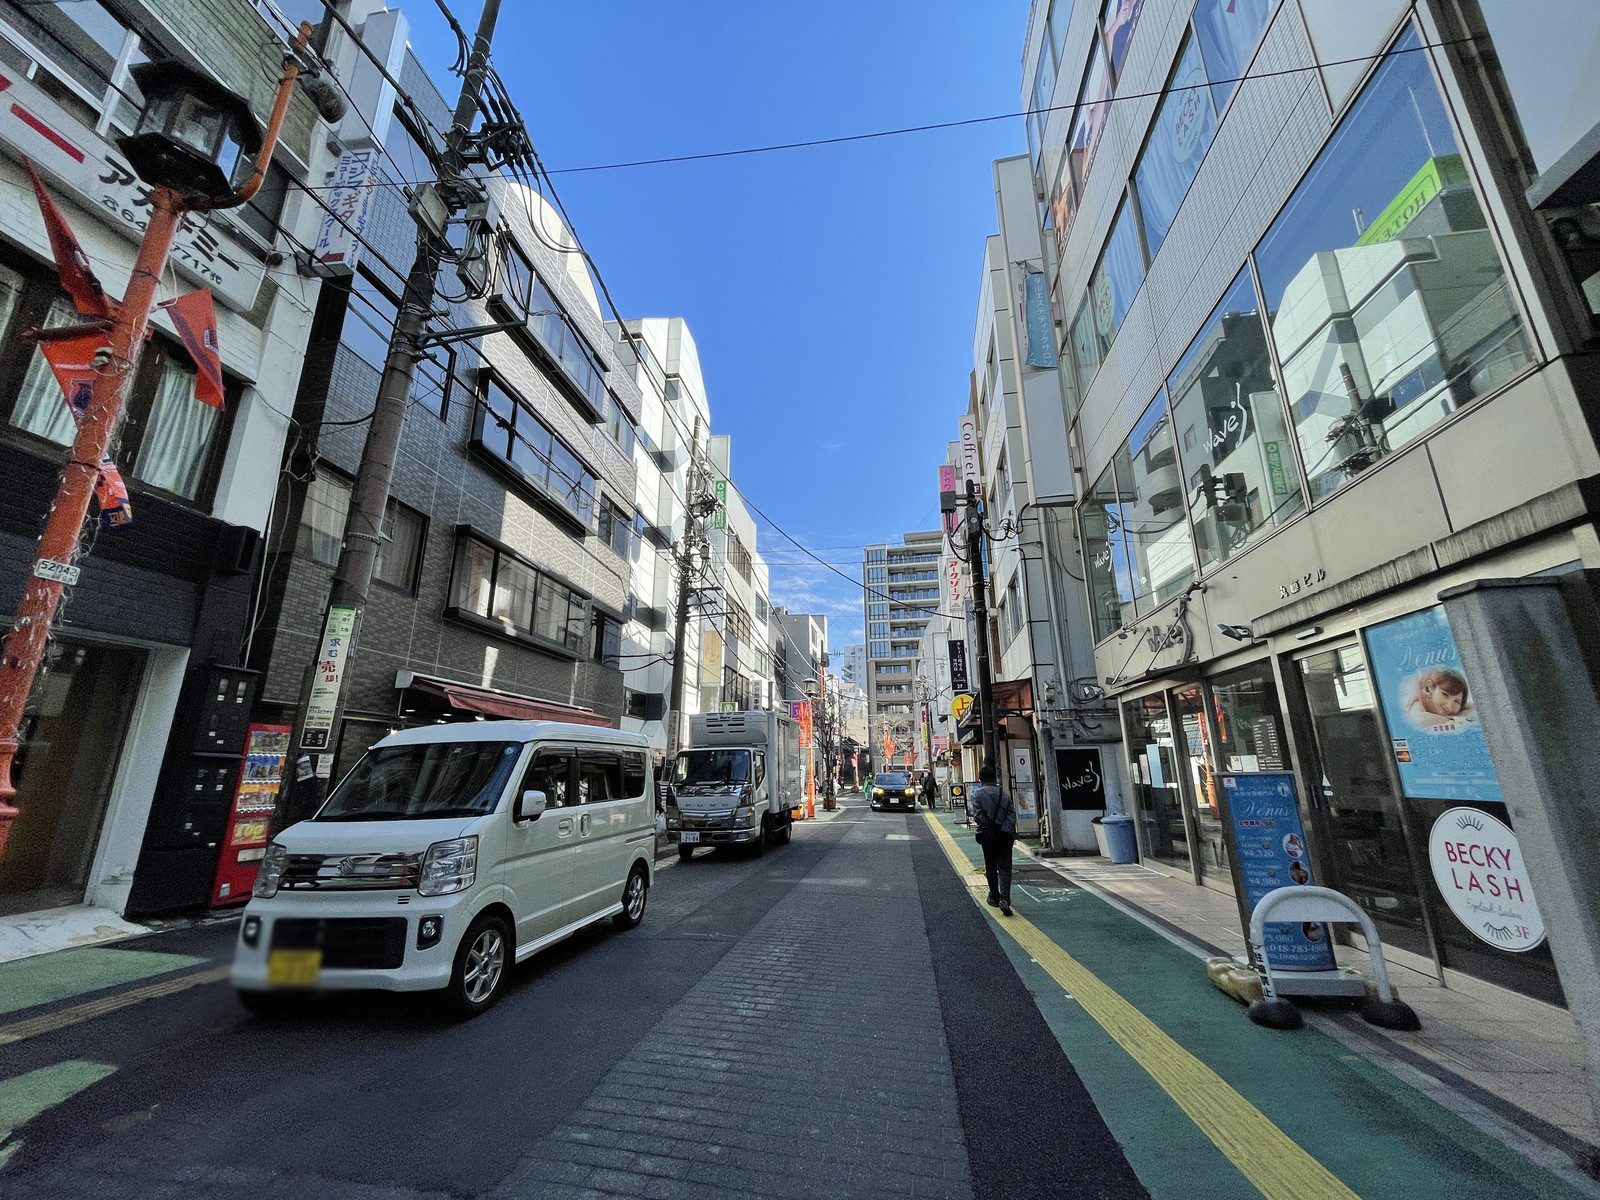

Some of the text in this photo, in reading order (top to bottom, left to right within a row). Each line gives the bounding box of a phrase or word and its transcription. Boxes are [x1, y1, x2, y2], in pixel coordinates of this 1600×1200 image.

[961, 421, 977, 477] Coffret
[1445, 841, 1511, 871] BECKY
[1451, 867, 1524, 903] LASH
[1514, 924, 1530, 940] 3F
